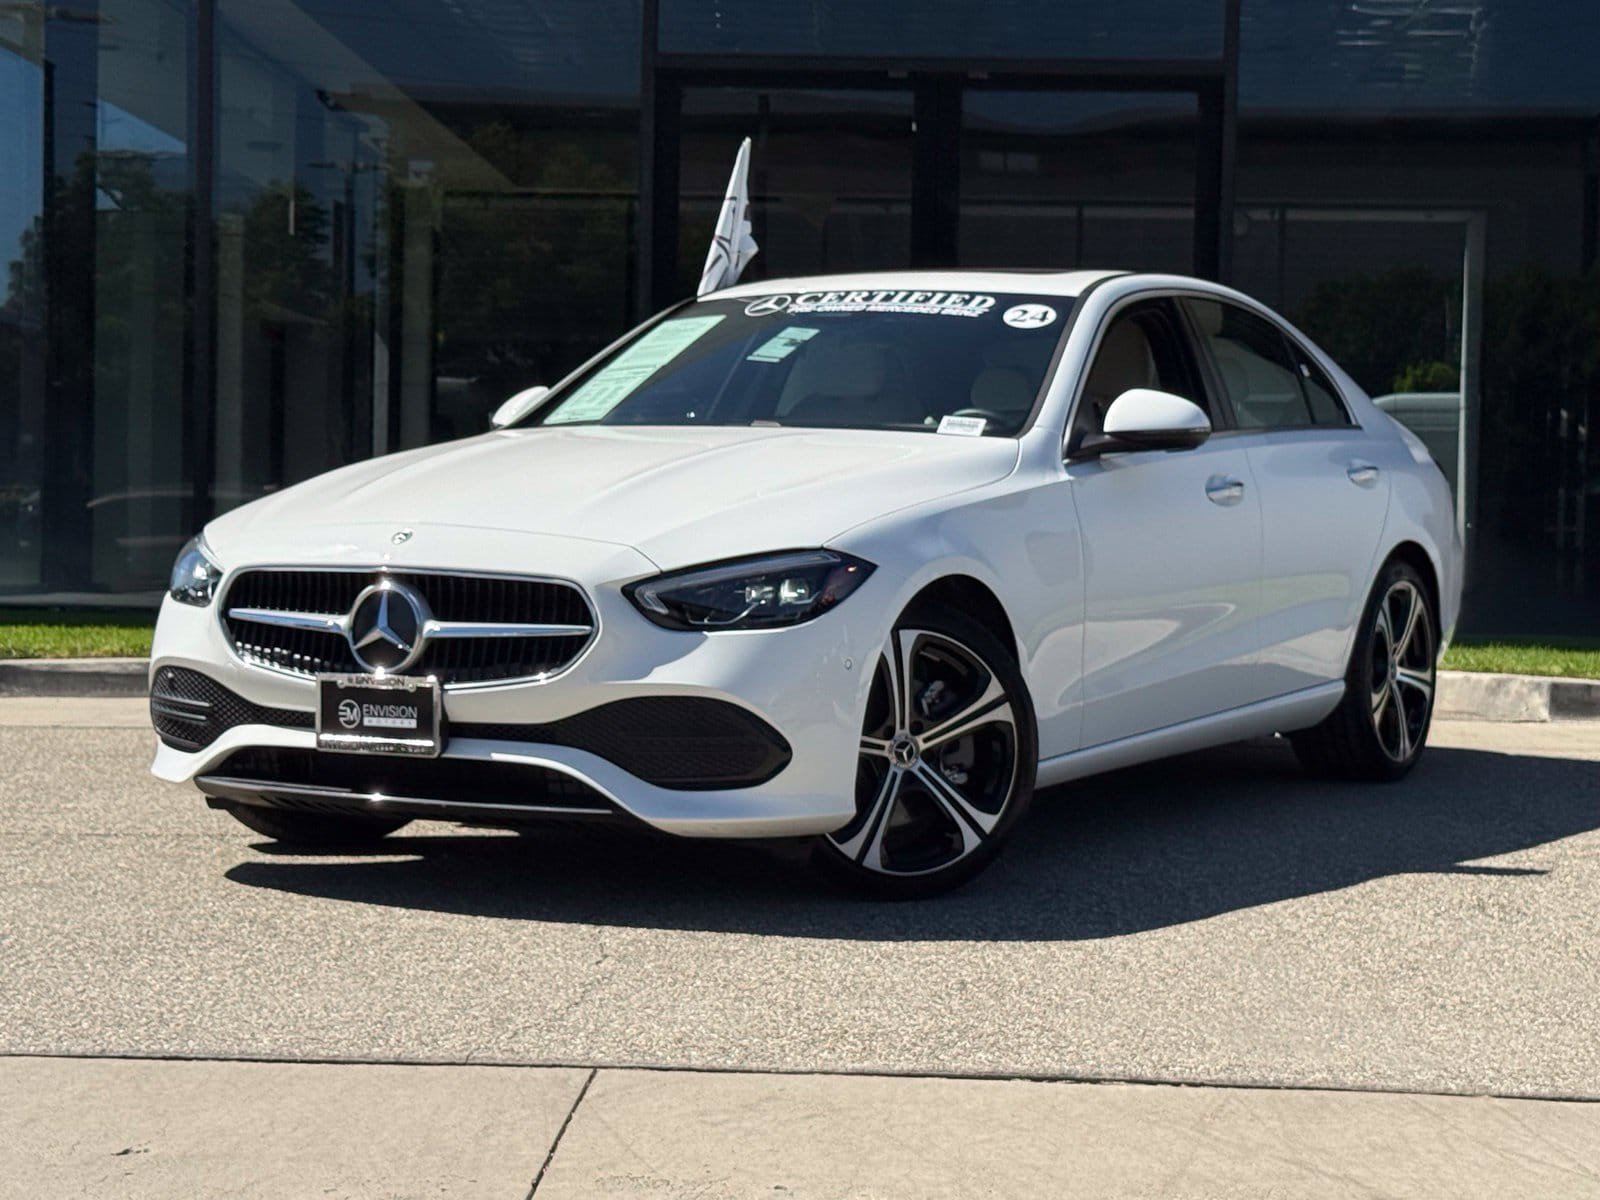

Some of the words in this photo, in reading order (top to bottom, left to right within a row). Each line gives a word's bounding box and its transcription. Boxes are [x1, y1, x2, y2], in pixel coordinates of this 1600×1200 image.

[796, 290, 996, 309] CERTIFIED
[1010, 308, 1049, 323] 24
[363, 703, 418, 719] ENVISION
[367, 718, 413, 726] MOTORS
